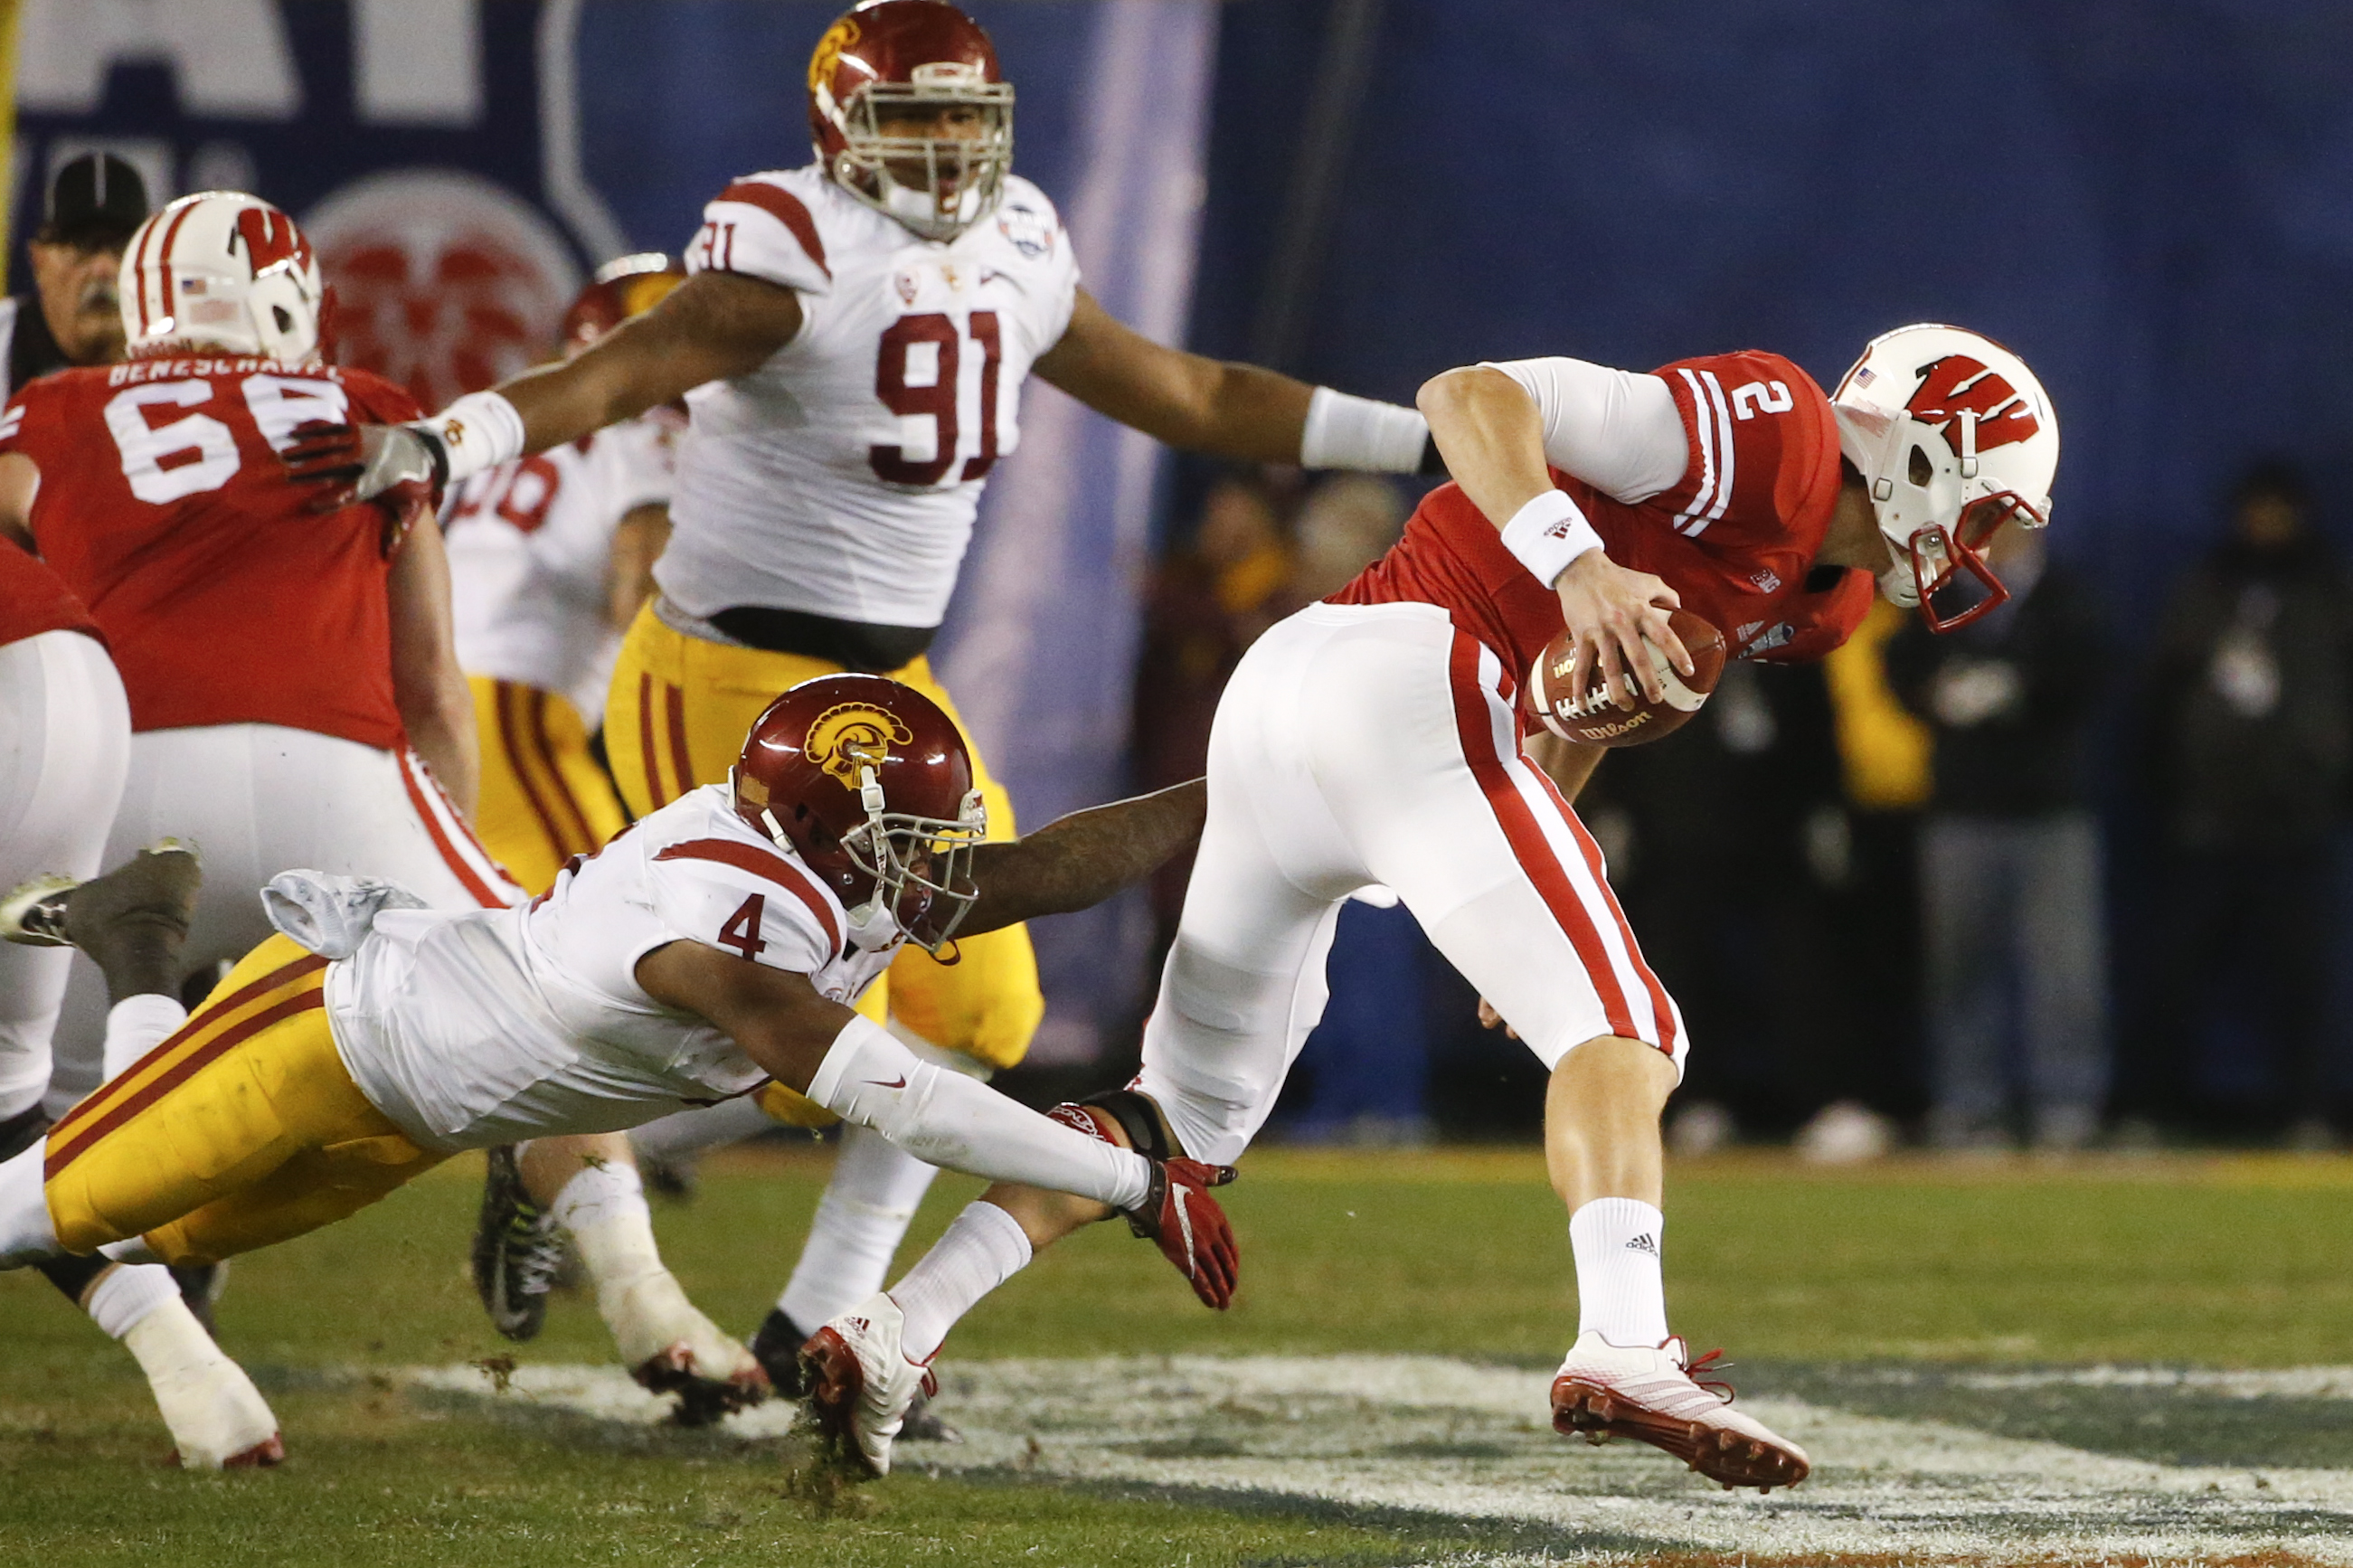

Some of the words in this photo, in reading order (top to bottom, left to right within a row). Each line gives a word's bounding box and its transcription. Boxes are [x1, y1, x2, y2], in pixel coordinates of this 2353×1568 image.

[868, 311, 1001, 486] 91
[1730, 378, 1794, 421] 2
[1578, 711, 1653, 740] Wilson
[717, 893, 766, 960] 4
